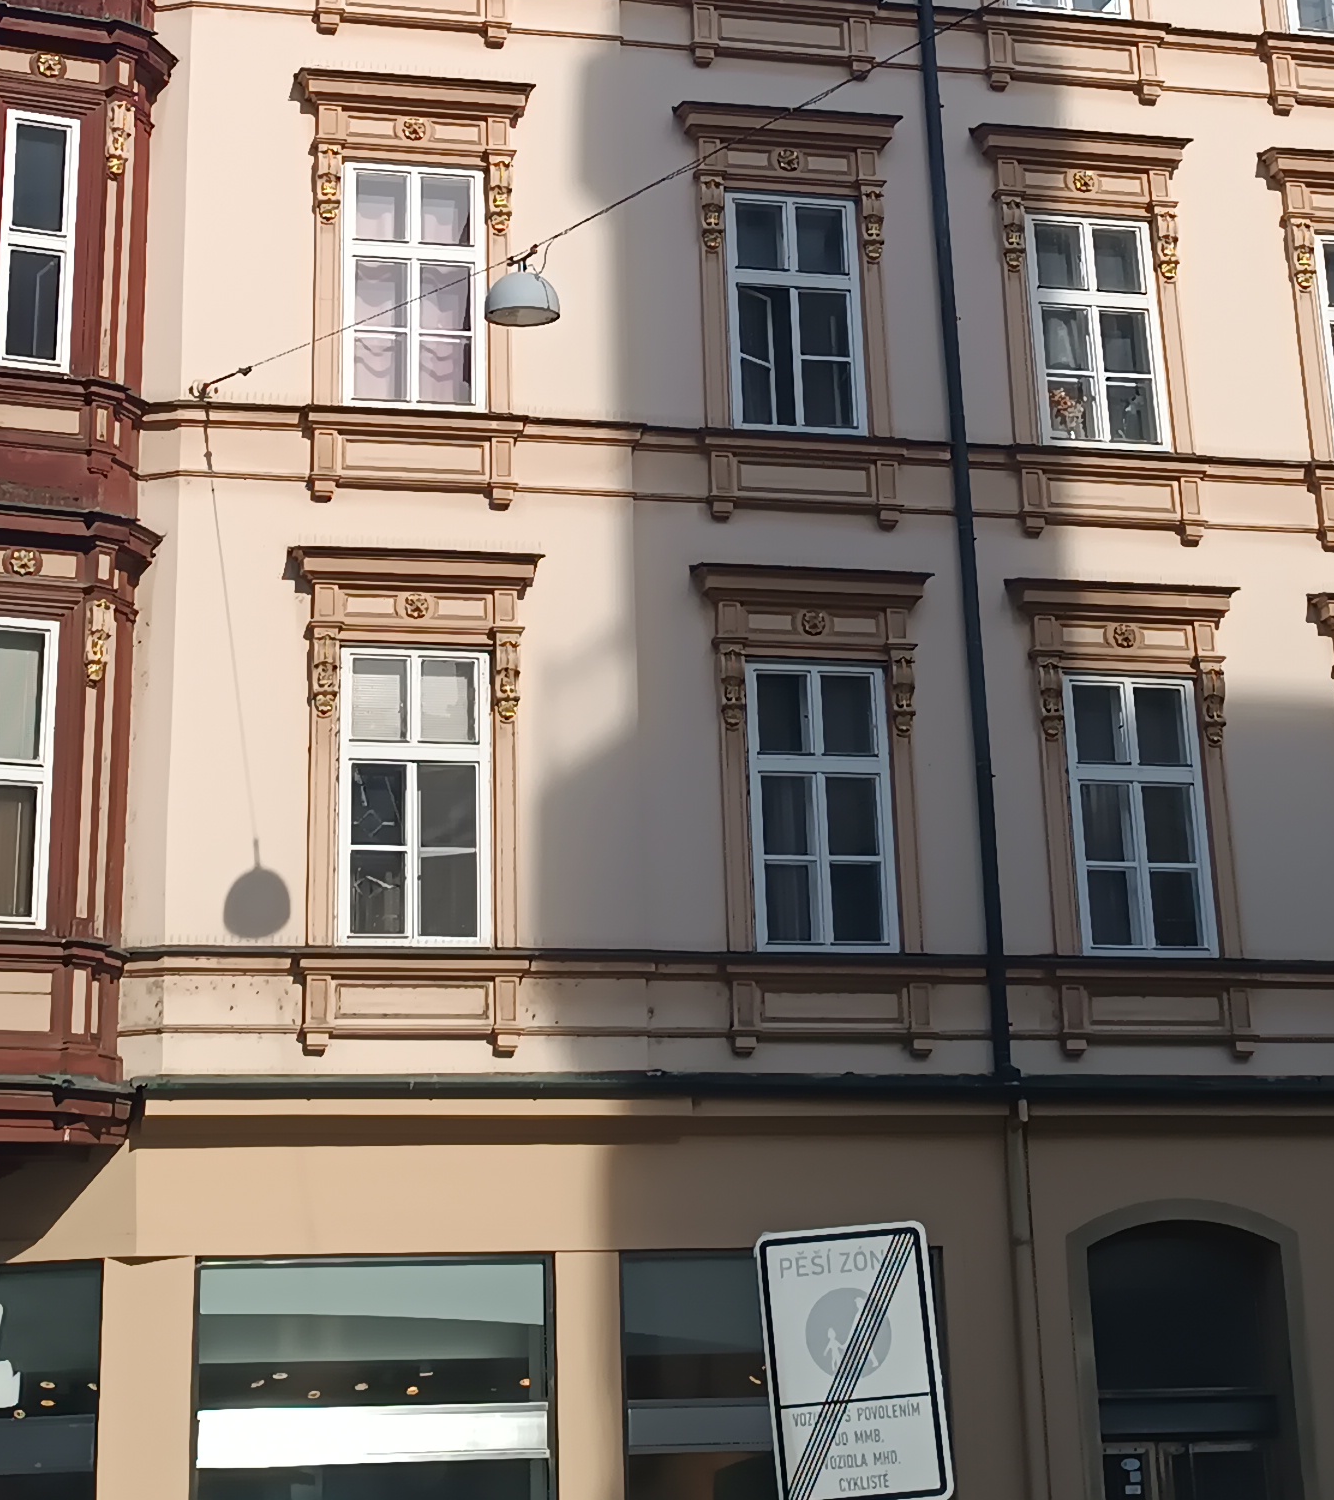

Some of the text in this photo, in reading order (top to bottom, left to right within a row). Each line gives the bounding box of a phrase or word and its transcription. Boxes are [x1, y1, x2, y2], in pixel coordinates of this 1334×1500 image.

[778, 1246, 886, 1279] PĚŠÍ ZÓN
[856, 1400, 921, 1422] POVOLENÍM
[854, 1428, 885, 1444] MMB.
[838, 1470, 890, 1493] CYKLISTÉ
